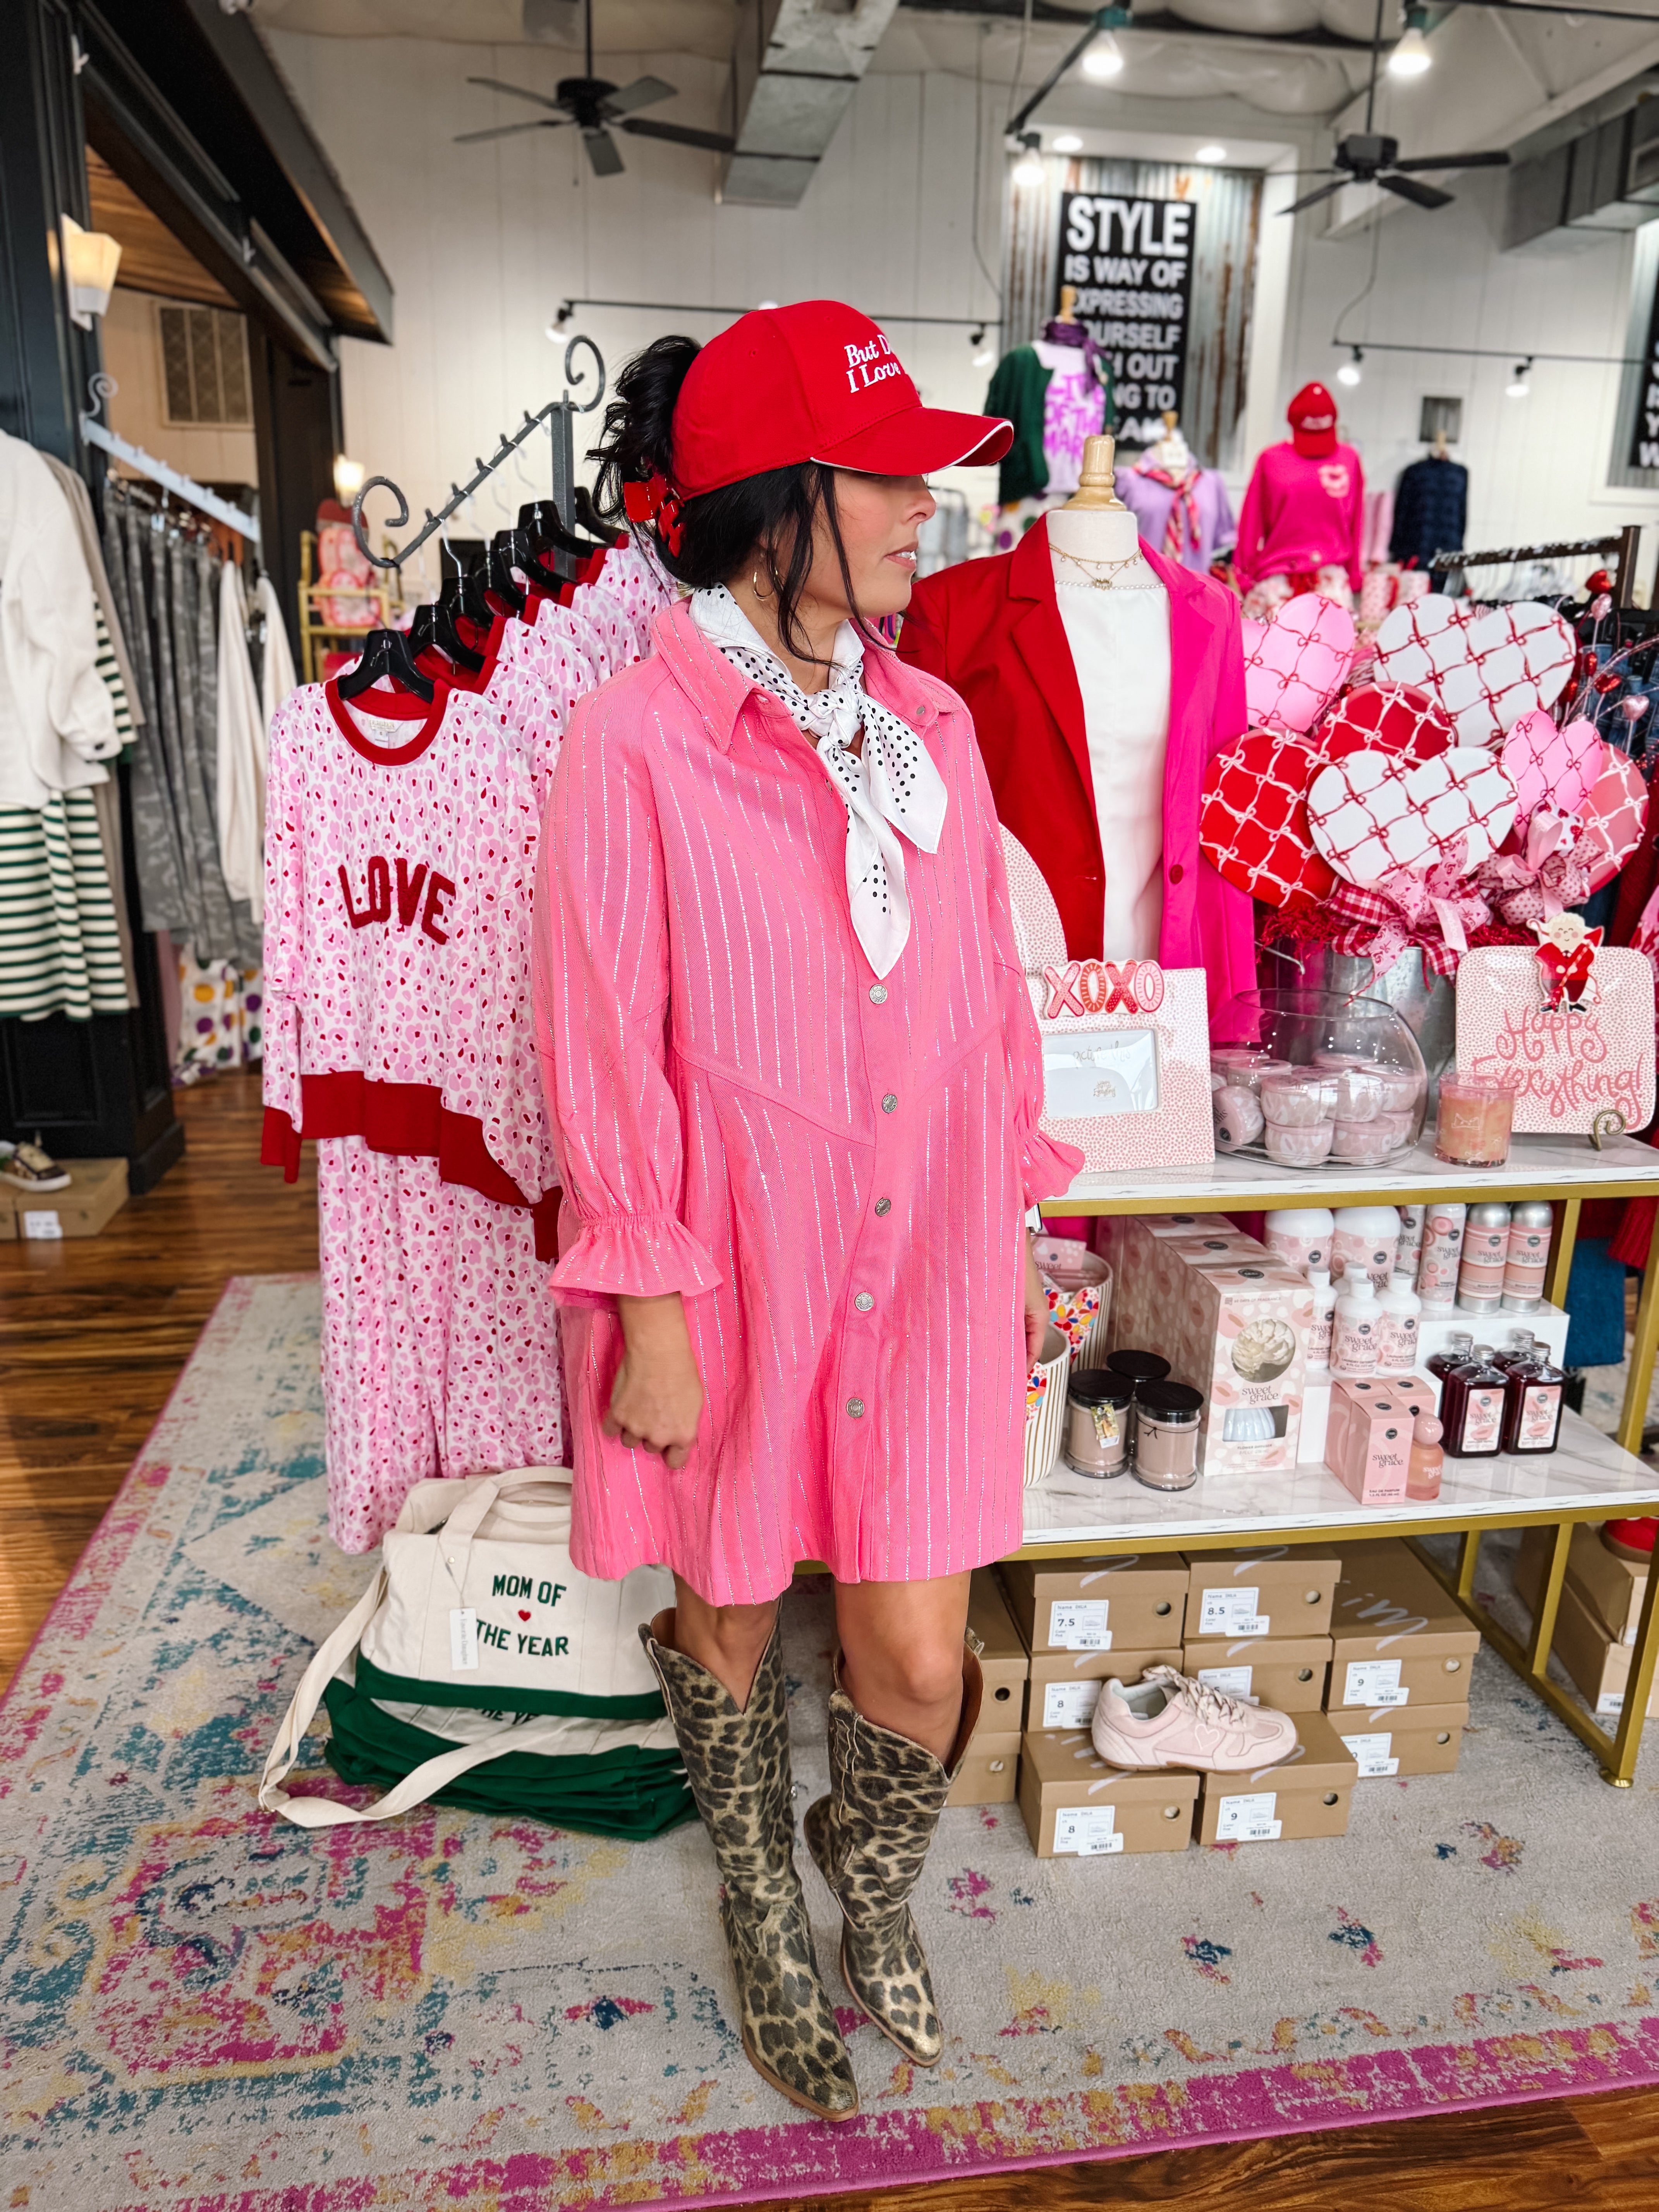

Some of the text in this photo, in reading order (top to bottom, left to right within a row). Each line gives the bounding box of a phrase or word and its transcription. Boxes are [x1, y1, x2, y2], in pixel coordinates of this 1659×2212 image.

[1066, 195, 1190, 258] STYLE
[1065, 254, 1187, 288] IS WAY OF
[1073, 287, 1184, 319] XPRESSING
[1083, 319, 1182, 350] OURSELF
[844, 340, 879, 368] But
[1127, 352, 1180, 380] OUT
[846, 369, 860, 393] I
[1146, 384, 1176, 410] TO
[338, 856, 455, 945] LOVE
[1044, 959, 1164, 1019] XOXO
[1495, 1006, 1607, 1063] Happy
[1367, 1272, 1388, 1281] eet
[1345, 1335, 1372, 1344] sweet
[1352, 1343, 1377, 1352] grace
[1242, 1385, 1272, 1395] sweet
[1250, 1393, 1279, 1405] grace
[1379, 1459, 1404, 1468] grace
[492, 1574, 567, 1607] MOM OF
[1058, 1618, 1075, 1626] 7.5
[1207, 1607, 1225, 1615] 8.5
[476, 1618, 569, 1656] THE YEAR
[1068, 1825, 1075, 1833] 8
[1231, 1812, 1237, 1820] 9
